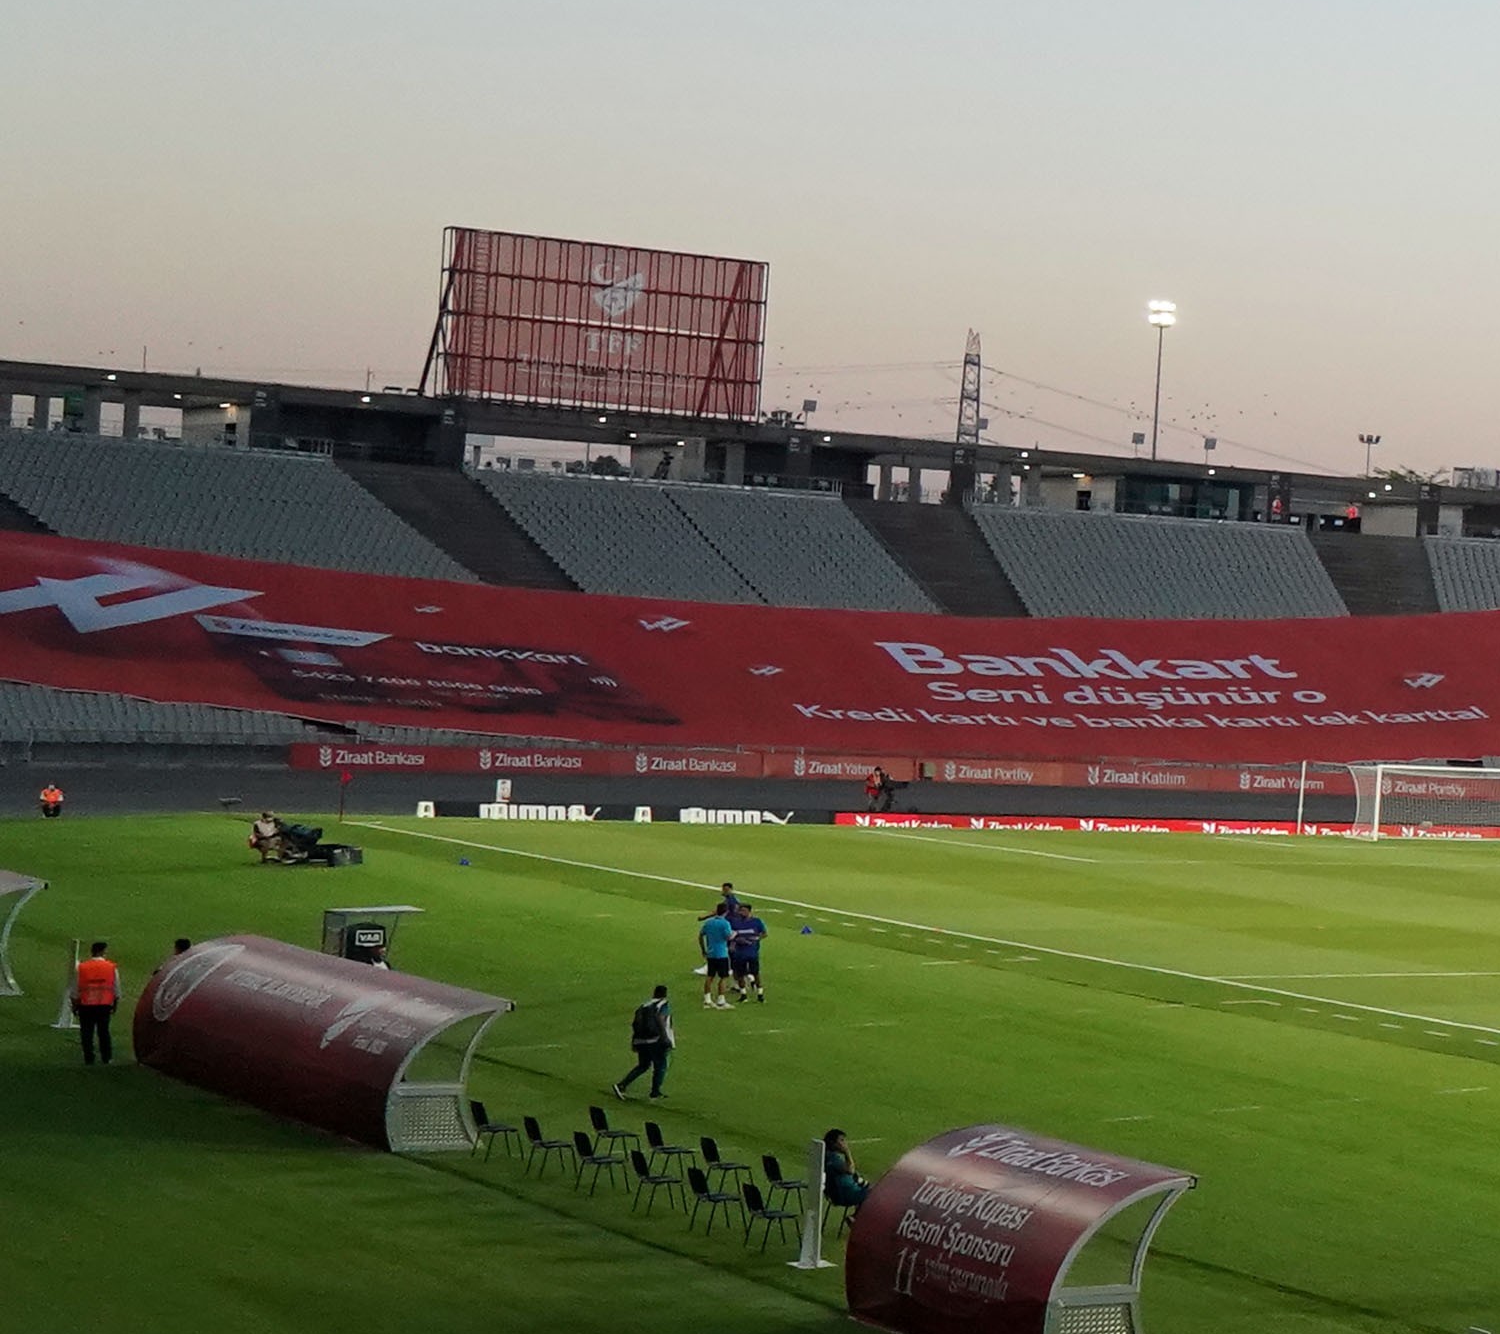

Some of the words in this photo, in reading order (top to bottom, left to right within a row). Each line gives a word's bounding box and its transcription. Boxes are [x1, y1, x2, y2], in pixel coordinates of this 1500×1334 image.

[874, 641, 1297, 680] Bankkart
[926, 681, 1060, 705] Seni
[1077, 684, 1282, 711] düşünür
[1292, 689, 1327, 705] o
[794, 702, 914, 723] Kredi
[917, 708, 1014, 726] kartı
[1022, 715, 1075, 727] ve
[1074, 713, 1206, 729] banka
[1206, 713, 1299, 728] kartı
[1302, 710, 1367, 727] tek
[336, 750, 374, 765] Ziraat
[375, 752, 424, 766] Bankası
[495, 754, 535, 767] Ziraat
[535, 755, 583, 769] Bankası
[651, 757, 688, 771] Ziraat
[689, 759, 736, 772] Bankası
[959, 766, 993, 779] Ziraat
[1104, 769, 1140, 784] Ziraat
[1142, 771, 1186, 785] Katılım
[359, 933, 380, 942] VAR
[976, 1132, 1045, 1166] Ziraat
[1039, 1153, 1130, 1187] Bankası
[912, 1175, 975, 1218] Türkiye
[970, 1196, 1033, 1231] Kupası
[896, 1209, 947, 1246] Resmi
[942, 1218, 1016, 1267] Sponsoru
